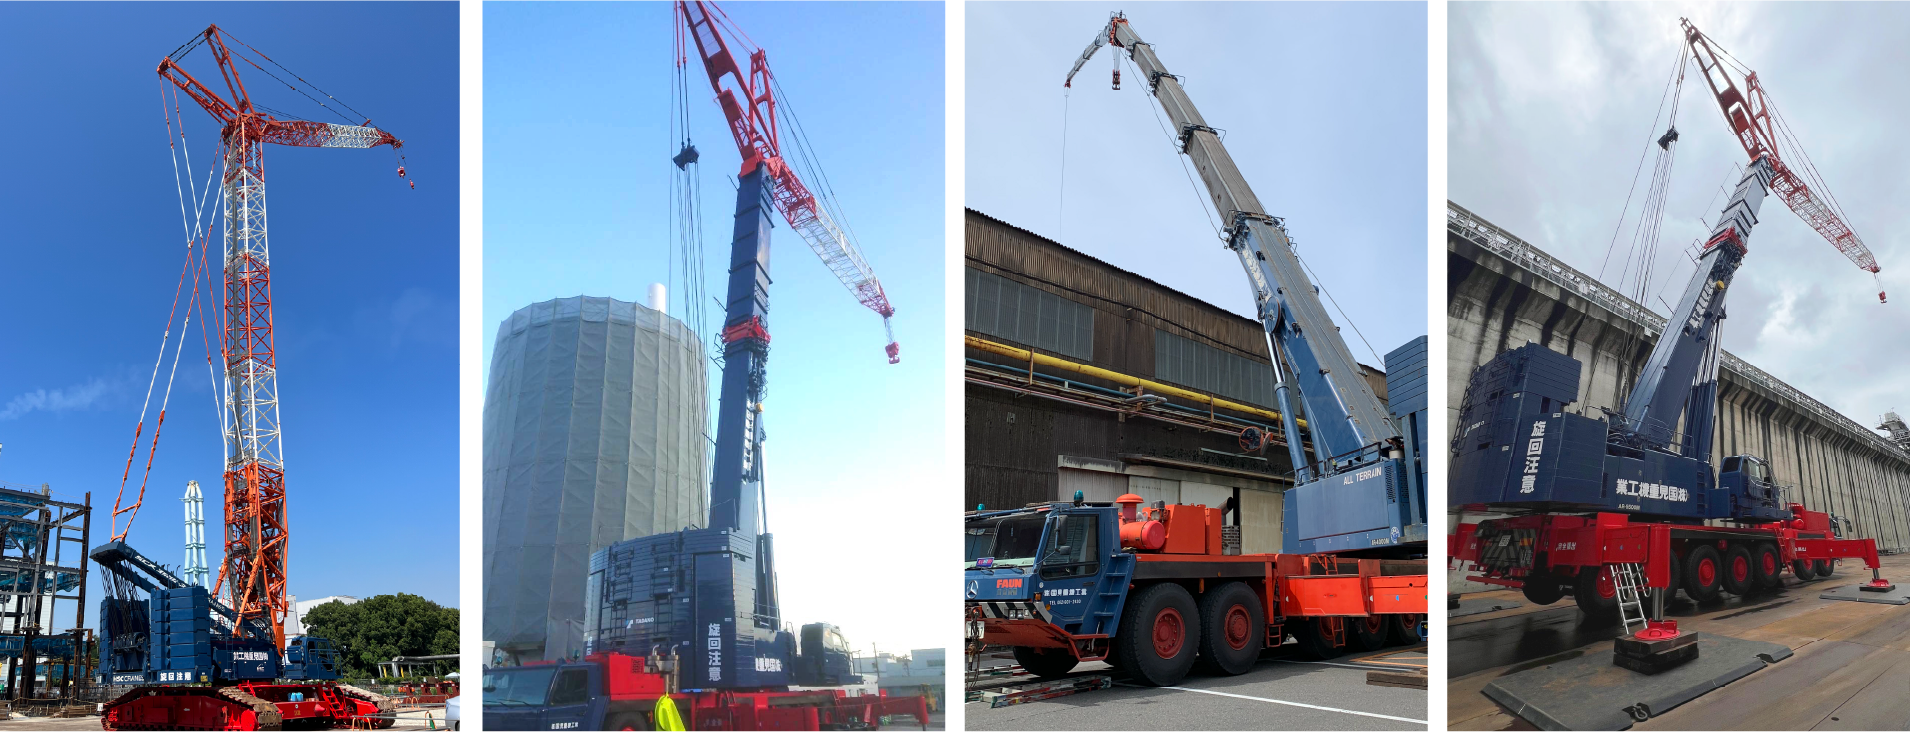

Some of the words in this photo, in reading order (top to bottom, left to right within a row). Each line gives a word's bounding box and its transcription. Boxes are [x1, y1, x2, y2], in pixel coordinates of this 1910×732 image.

[1520, 420, 1547, 494] 旋回注意
[1343, 476, 1354, 486] ALL
[1356, 467, 1382, 482] TERRAIN
[996, 579, 1023, 588] FAUN
[635, 617, 655, 625] TADANO
[708, 623, 722, 682] 旋回注意
